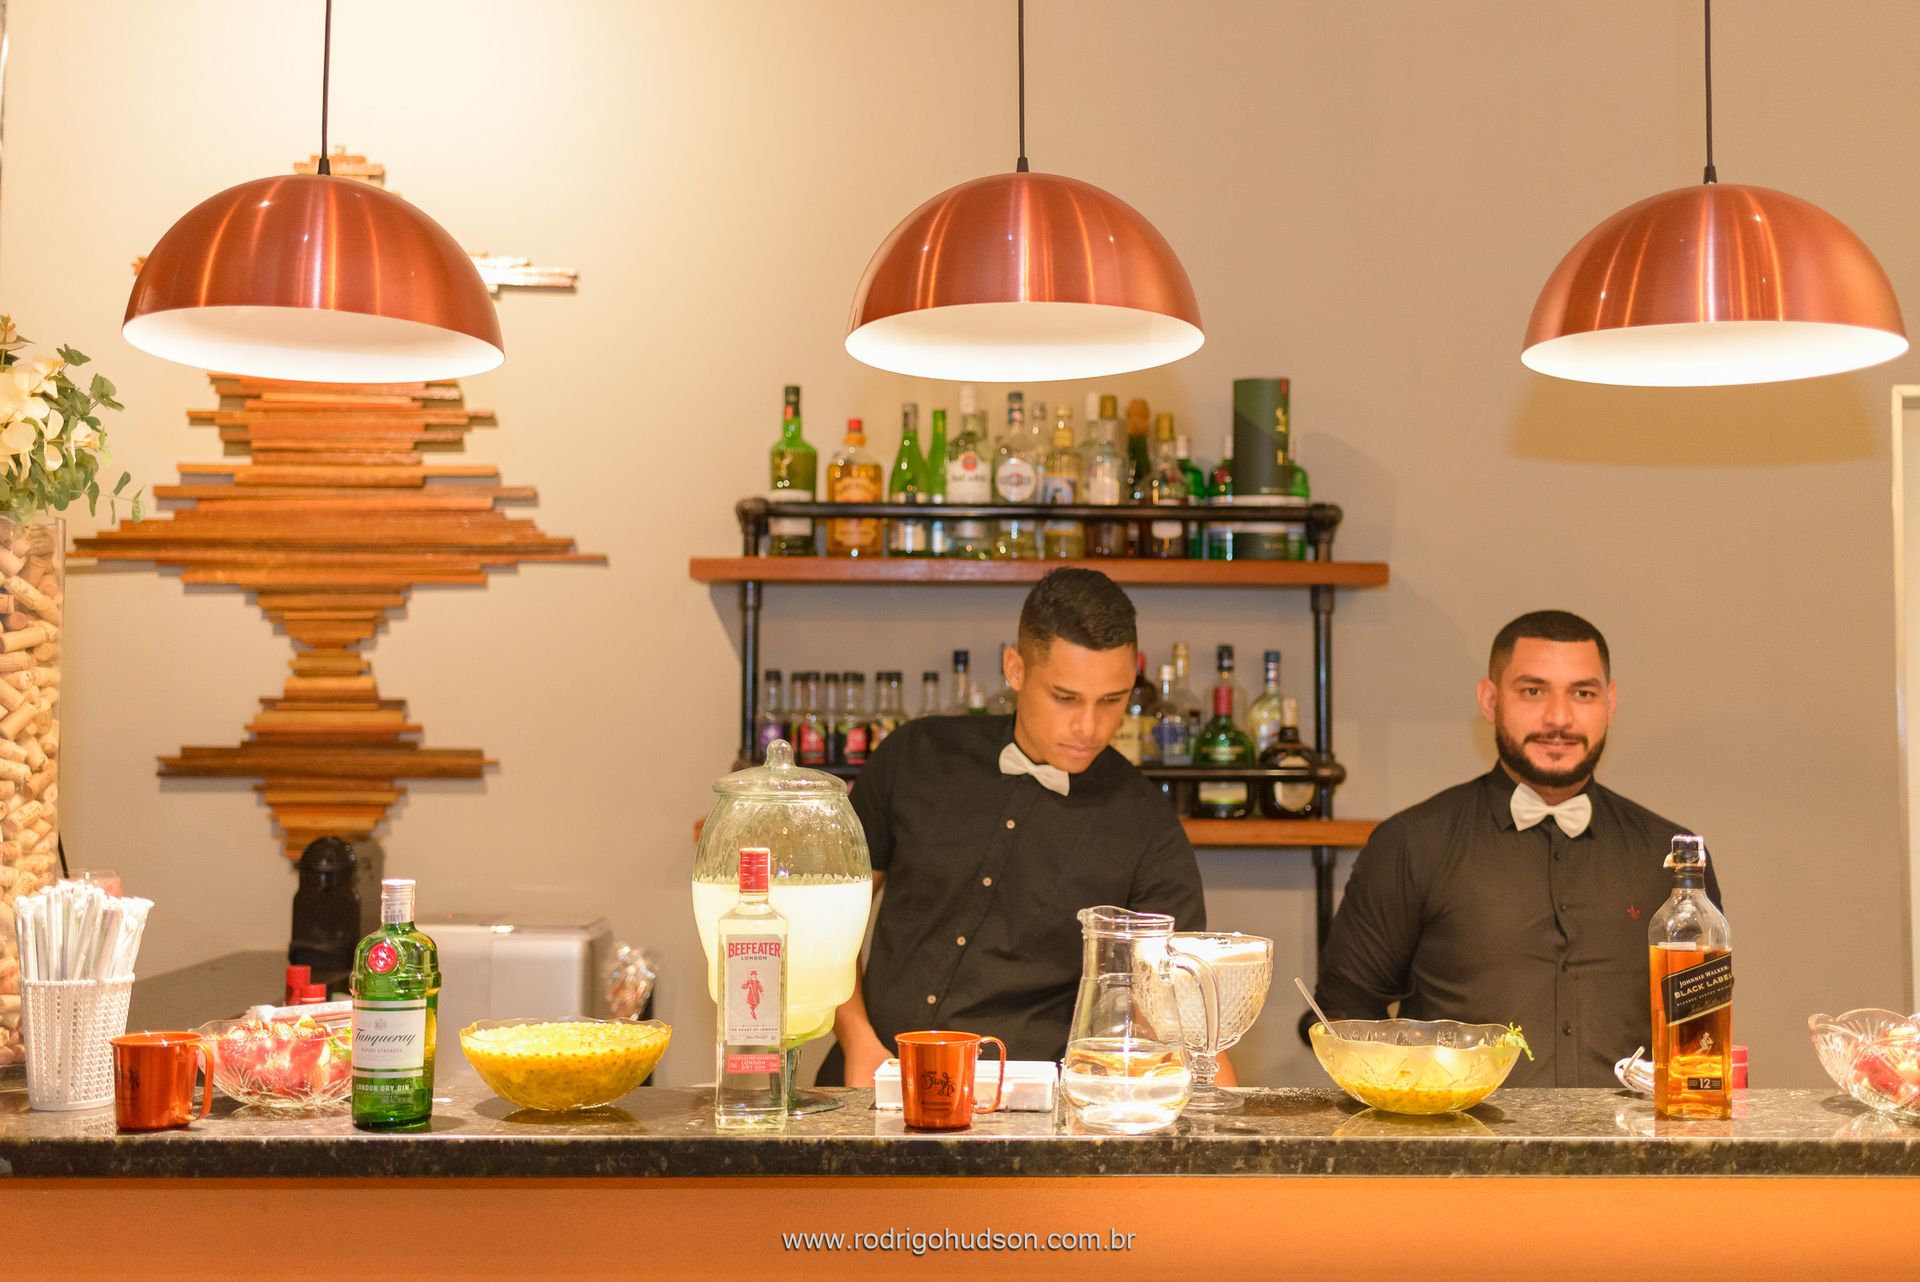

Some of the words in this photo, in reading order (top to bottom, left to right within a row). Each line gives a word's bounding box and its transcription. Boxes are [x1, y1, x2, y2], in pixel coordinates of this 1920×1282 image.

[728, 942, 780, 959] BEEFEATER
[1674, 983, 1705, 999] BLACK
[1706, 973, 1732, 987] LABEL
[1679, 974, 1705, 989] JOHNNIE
[1705, 965, 1728, 978] WALKER
[355, 1028, 416, 1047] Tanqueray
[356, 1083, 379, 1092] LONDON
[380, 1084, 395, 1092] DRY
[397, 1083, 410, 1092] GIN
[1699, 1078, 1711, 1089] 12
